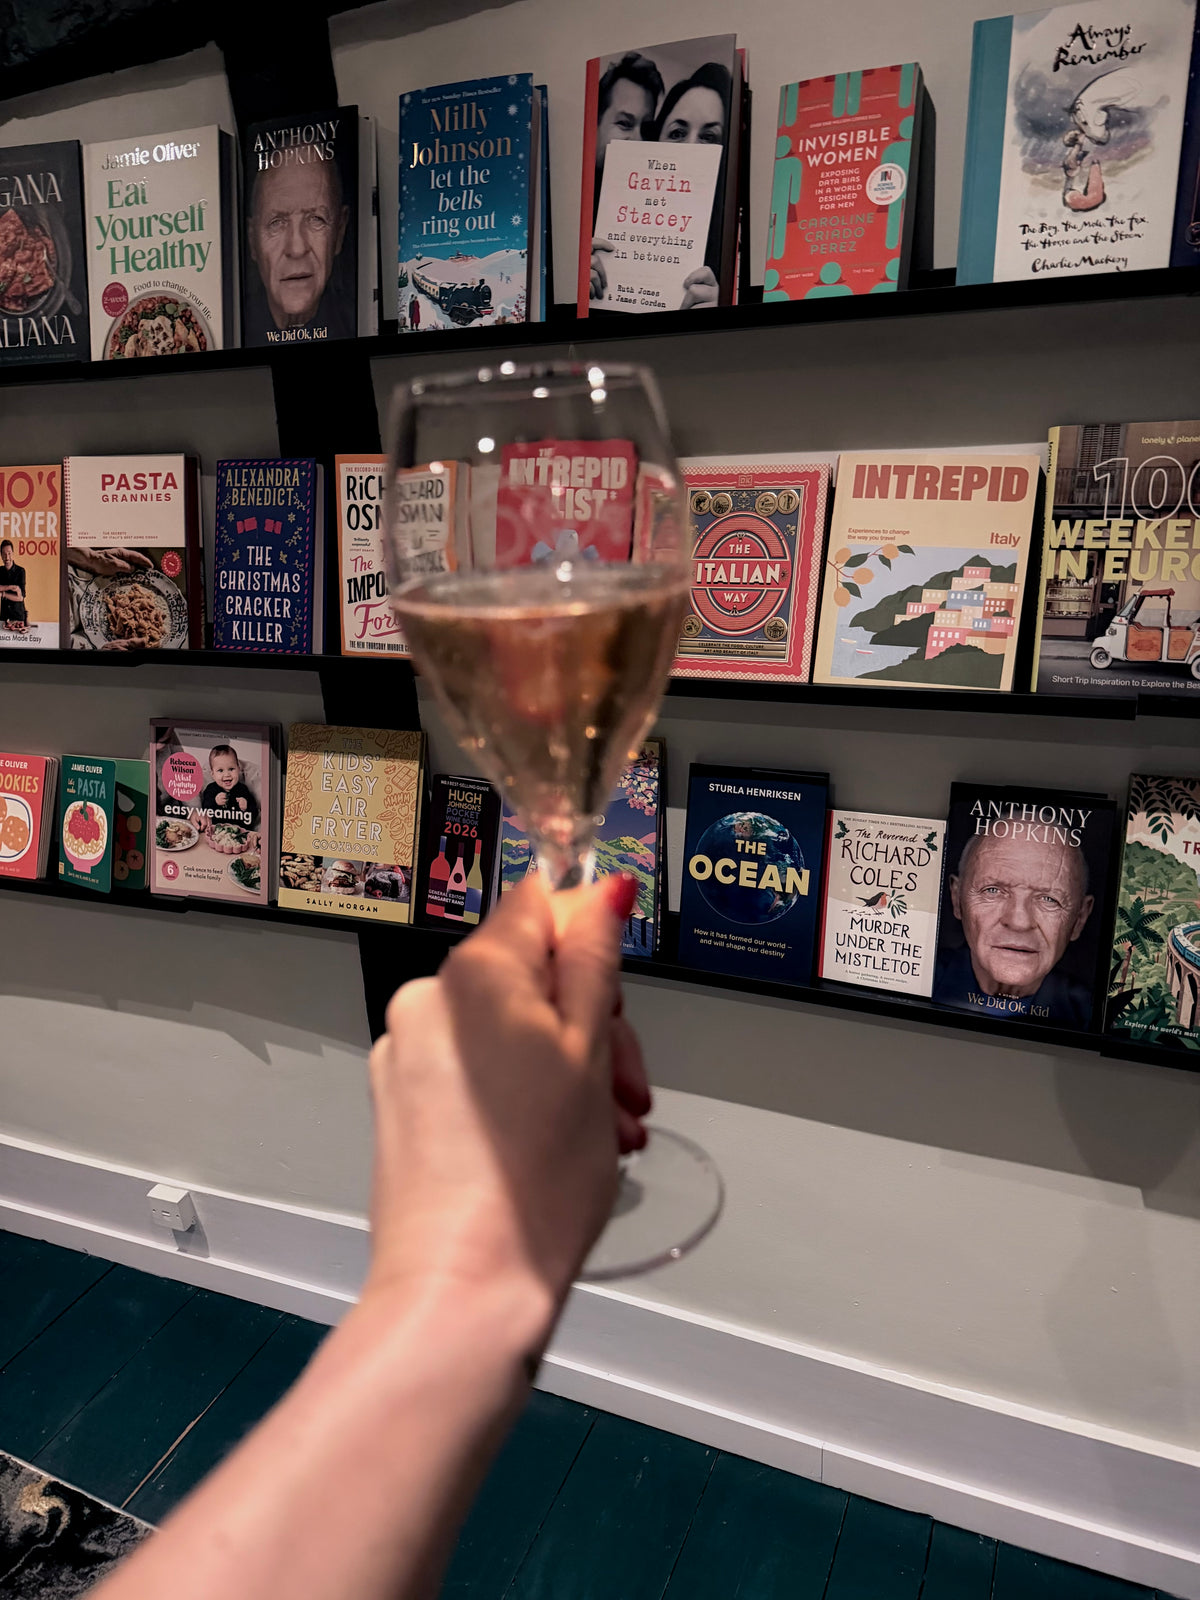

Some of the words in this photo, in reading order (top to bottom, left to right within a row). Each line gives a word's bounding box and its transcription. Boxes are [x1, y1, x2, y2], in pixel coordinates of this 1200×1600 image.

[1065, 23, 1132, 50] Always
[1052, 42, 1148, 72] Remember
[429, 102, 489, 135] Milly
[254, 119, 340, 152] ANTHONY
[798, 127, 891, 152] INVISIBLE
[102, 147, 150, 170] Jamie
[153, 143, 200, 162] Oliver
[258, 141, 335, 171] HOPKINS
[409, 136, 512, 168] Johnson
[806, 146, 878, 168] WOMEN
[648, 160, 677, 171] When
[820, 168, 860, 179] EXPOSING
[430, 169, 452, 189] let
[460, 165, 490, 186] the
[628, 172, 691, 193] Gavin
[819, 177, 840, 187] DATA
[842, 175, 861, 185] BIAS
[107, 177, 149, 209] Eat
[815, 187, 824, 196] IN
[833, 184, 862, 193] WORLD
[819, 193, 858, 202] DESIGNED
[438, 189, 483, 213] bells
[645, 197, 667, 206] met
[820, 203, 836, 211] FOR
[837, 201, 855, 210] MEN
[421, 215, 460, 237] ring
[465, 211, 496, 231] out
[617, 205, 692, 232] Stacey
[798, 213, 875, 230] CAROLINE
[607, 232, 626, 241] and
[630, 234, 694, 249] everything
[804, 227, 865, 243] CRIADO
[110, 238, 212, 275] Healthy
[614, 250, 627, 259] in
[633, 251, 680, 264] between
[810, 241, 857, 255] PEREZ
[133, 281, 151, 293] Food
[162, 280, 188, 294] change
[187, 291, 204, 307] your
[202, 306, 212, 320] life
[616, 295, 637, 305] James
[617, 284, 635, 294] Ruth
[638, 288, 660, 297] Jones
[267, 331, 281, 342] We
[281, 329, 296, 342] Did
[313, 326, 328, 339] Kid
[1142, 436, 1166, 445] lonely
[100, 472, 178, 491] PASTA
[225, 468, 300, 488] ALEXANDRA
[508, 455, 628, 489] INTREPID
[852, 464, 1030, 502] INTREPID
[101, 493, 172, 503] GRANNIES
[231, 487, 295, 507] BENEDICT
[0, 511, 58, 538] FRYER
[18, 540, 58, 556] BOOK
[729, 543, 751, 554] THE
[990, 532, 1021, 548] Italy
[246, 545, 272, 566] THE
[350, 555, 374, 573] The
[1047, 550, 1089, 580] IN
[219, 570, 301, 593] CHRISTMAS
[695, 562, 781, 585] ITALIAN
[225, 596, 291, 619] CRACKER
[723, 593, 748, 603] WAY
[232, 620, 283, 644] KILLER
[1052, 675, 1073, 683] Short
[1075, 676, 1089, 685] Trip
[1090, 677, 1130, 686] Inspiration
[1132, 679, 1140, 687] to
[1141, 679, 1170, 688] Explore
[5, 760, 28, 769] OLIVER
[169, 758, 197, 767] Rebecca
[171, 766, 194, 774] Wilson
[322, 750, 381, 773] KIDS'
[77, 777, 106, 799] PASTA
[321, 772, 378, 795] EASY
[709, 783, 744, 795] STURLA
[746, 788, 801, 801] HENRIKSEN
[329, 795, 367, 817] AIR
[447, 800, 482, 812] JOHNSON'S
[448, 789, 482, 804] HUGH
[164, 804, 194, 819] easy
[195, 807, 252, 823] weaning
[446, 807, 480, 819] POCKET
[970, 800, 1092, 829] ANTHONY
[311, 816, 382, 841] FRYER
[444, 821, 478, 838] 2026
[855, 829, 871, 839] The
[875, 829, 918, 843] Reverend
[974, 817, 1082, 847] HOPKINS
[312, 839, 379, 856] COOKBOOK
[735, 839, 767, 856] THE
[840, 838, 931, 867] RICHARD
[167, 864, 174, 875] 6
[689, 854, 810, 896] OCEAN
[850, 865, 917, 891] COLES
[306, 897, 333, 908] SALLY
[339, 901, 379, 913] MORGAN
[850, 916, 910, 939] MURDER
[713, 939, 724, 947] will
[725, 942, 746, 951] shape
[760, 948, 785, 958] destiny
[716, 931, 728, 939] has
[729, 933, 753, 943] formed
[767, 940, 786, 949] world
[835, 932, 886, 953] UNDER
[891, 940, 922, 959] THE
[835, 948, 920, 976] MISTLETOE
[967, 992, 984, 1006] We
[986, 996, 1006, 1010] Did
[1030, 1004, 1050, 1017] Kid
[1124, 1020, 1147, 1030] Explore
[1149, 1024, 1159, 1032] the
[1160, 1027, 1182, 1035] world's
